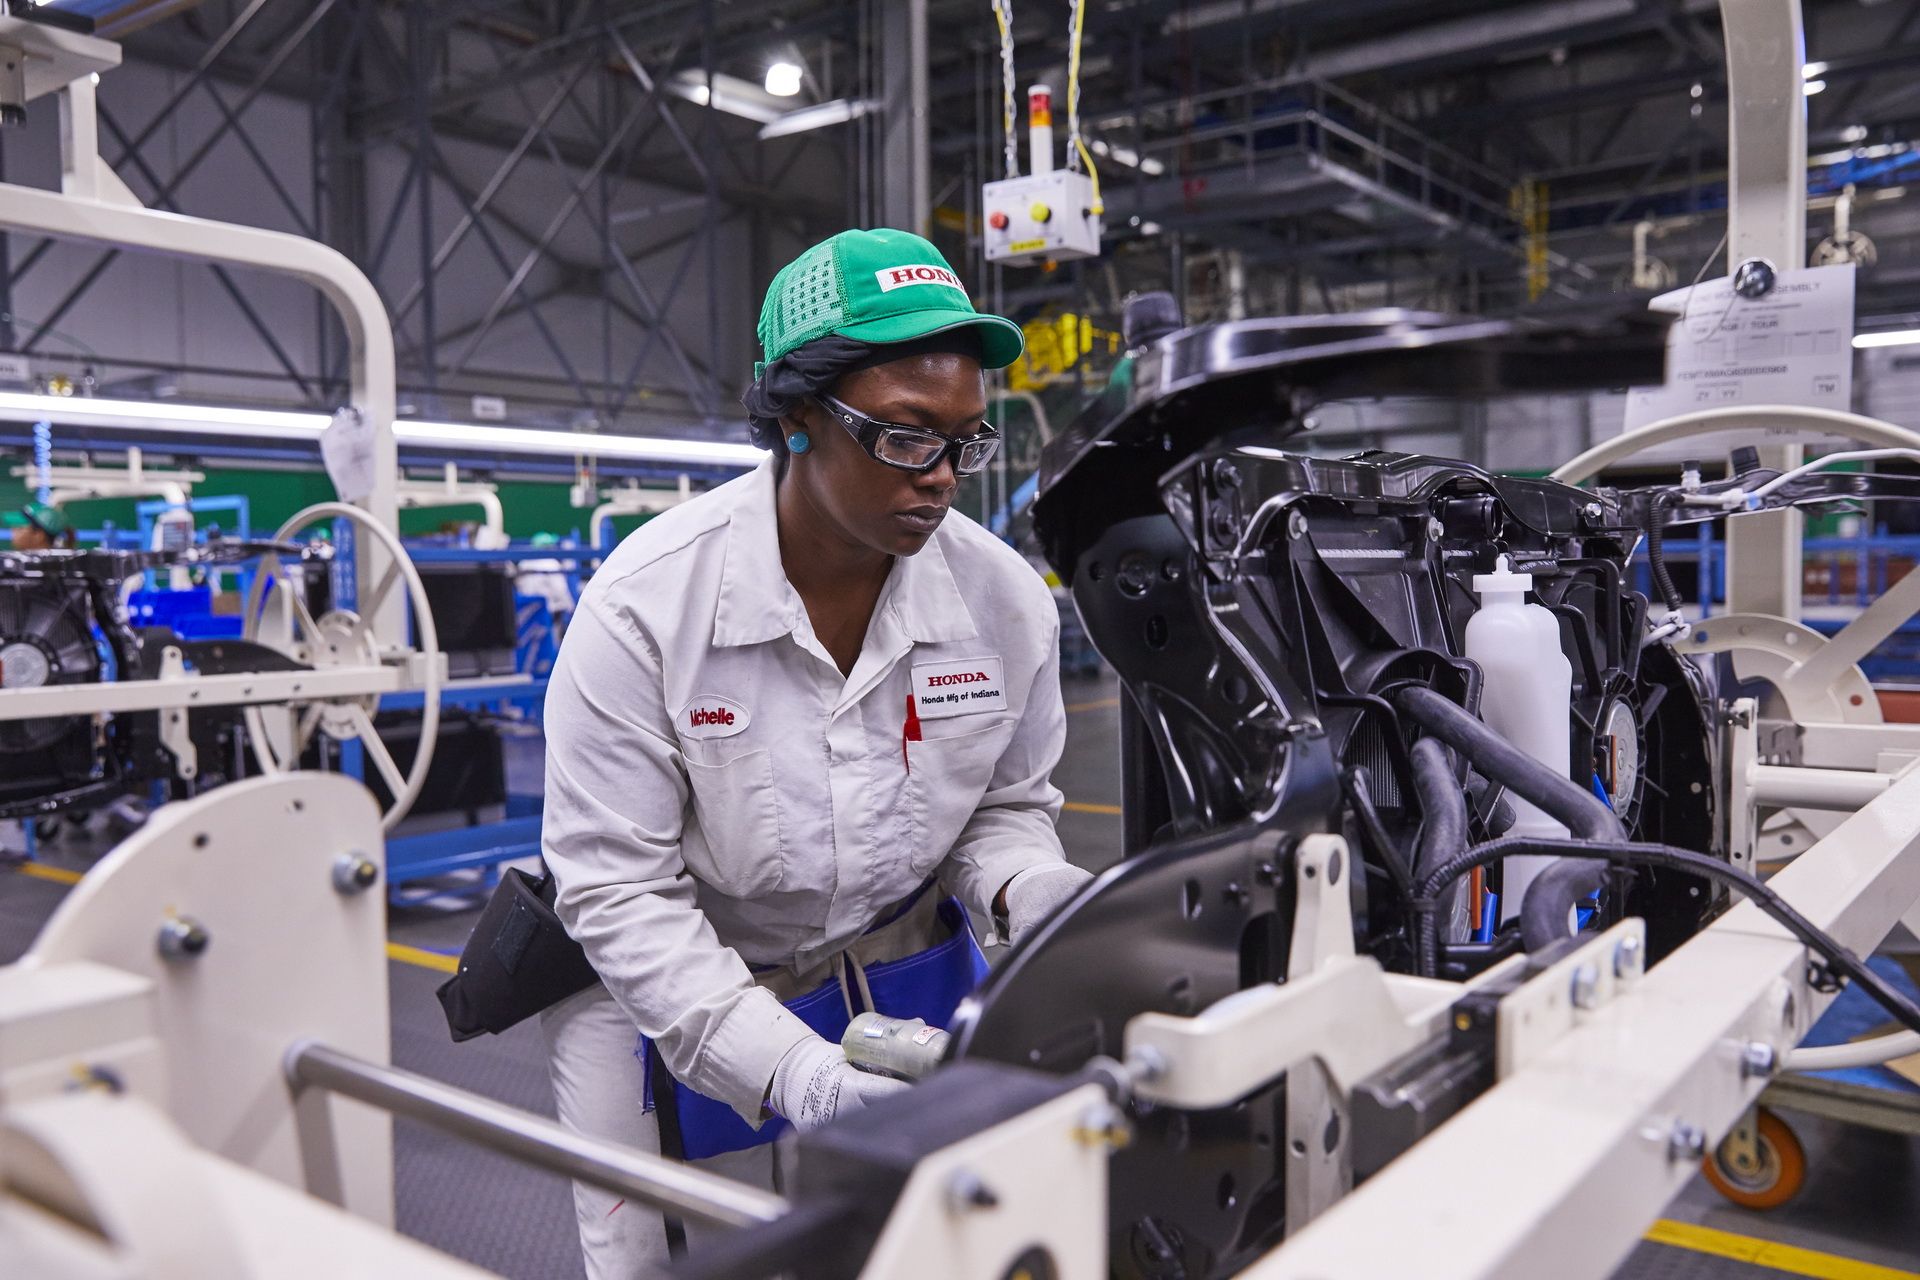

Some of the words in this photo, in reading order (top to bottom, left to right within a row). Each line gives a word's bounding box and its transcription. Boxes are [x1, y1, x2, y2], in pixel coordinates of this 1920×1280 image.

[928, 672, 990, 687] HONDA
[921, 695, 945, 705] Honda
[946, 693, 959, 703] Mfg
[960, 691, 969, 701] of
[971, 689, 1000, 699] Indiana
